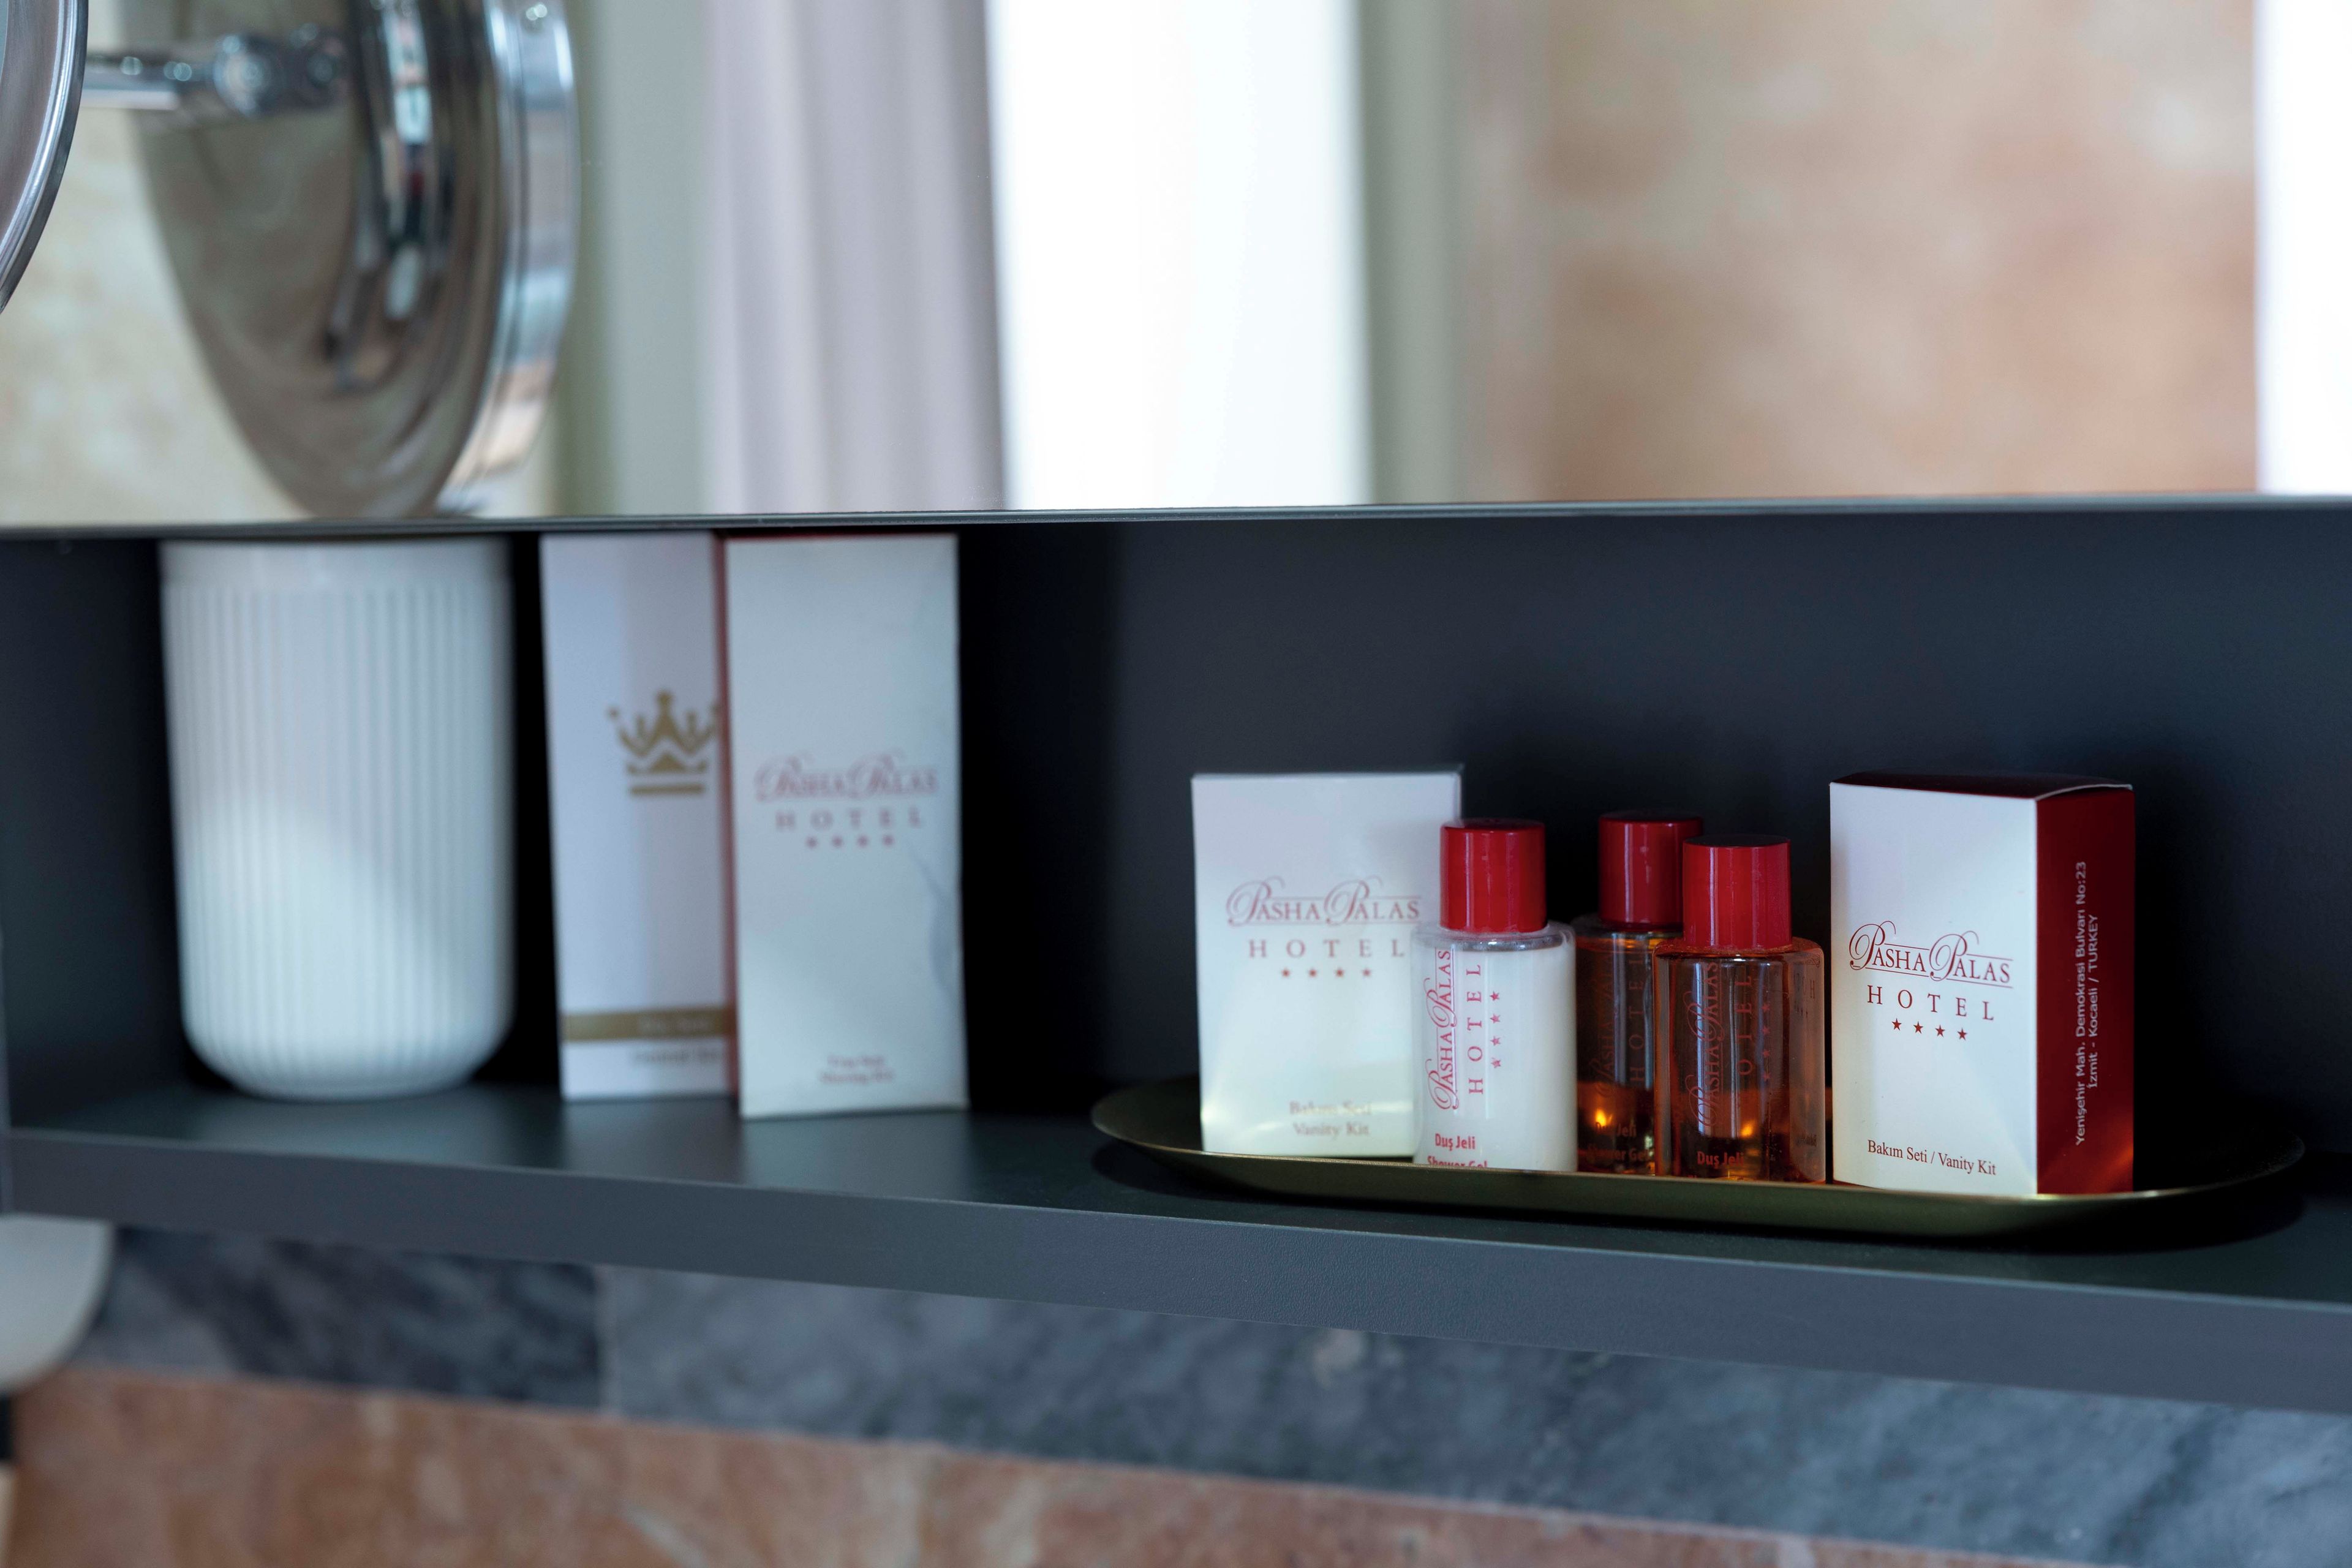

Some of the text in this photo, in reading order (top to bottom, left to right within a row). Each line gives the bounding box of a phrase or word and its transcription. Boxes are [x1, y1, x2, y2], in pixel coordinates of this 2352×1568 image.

[1226, 875, 1420, 926] PASHA PALAS
[1248, 939, 1405, 958] HOTEL
[1849, 921, 2010, 983] PASHA PALAS
[2088, 914, 2098, 973] TURKEY
[1867, 984, 1994, 1021] HOTEL
[2075, 861, 2087, 1146] Yenişehir Mah. Demokrasi Bulvarı No:23
[2088, 987, 2098, 1038] Kocaeli
[1423, 950, 1460, 1109] PASHA PALAS
[1466, 964, 1483, 1094] HOTEL
[1683, 962, 1725, 1127] PASHA PALAS
[2086, 1052, 2098, 1089] İzmit
[1434, 1133, 1476, 1151] Duş Jeli
[1697, 1151, 1744, 1169] Duş Jeli
[1868, 1139, 1904, 1159] Bakım
[1907, 1147, 1928, 1163] Seti
[1938, 1152, 1974, 1174] Vanity
[1977, 1159, 1997, 1175] Kit
